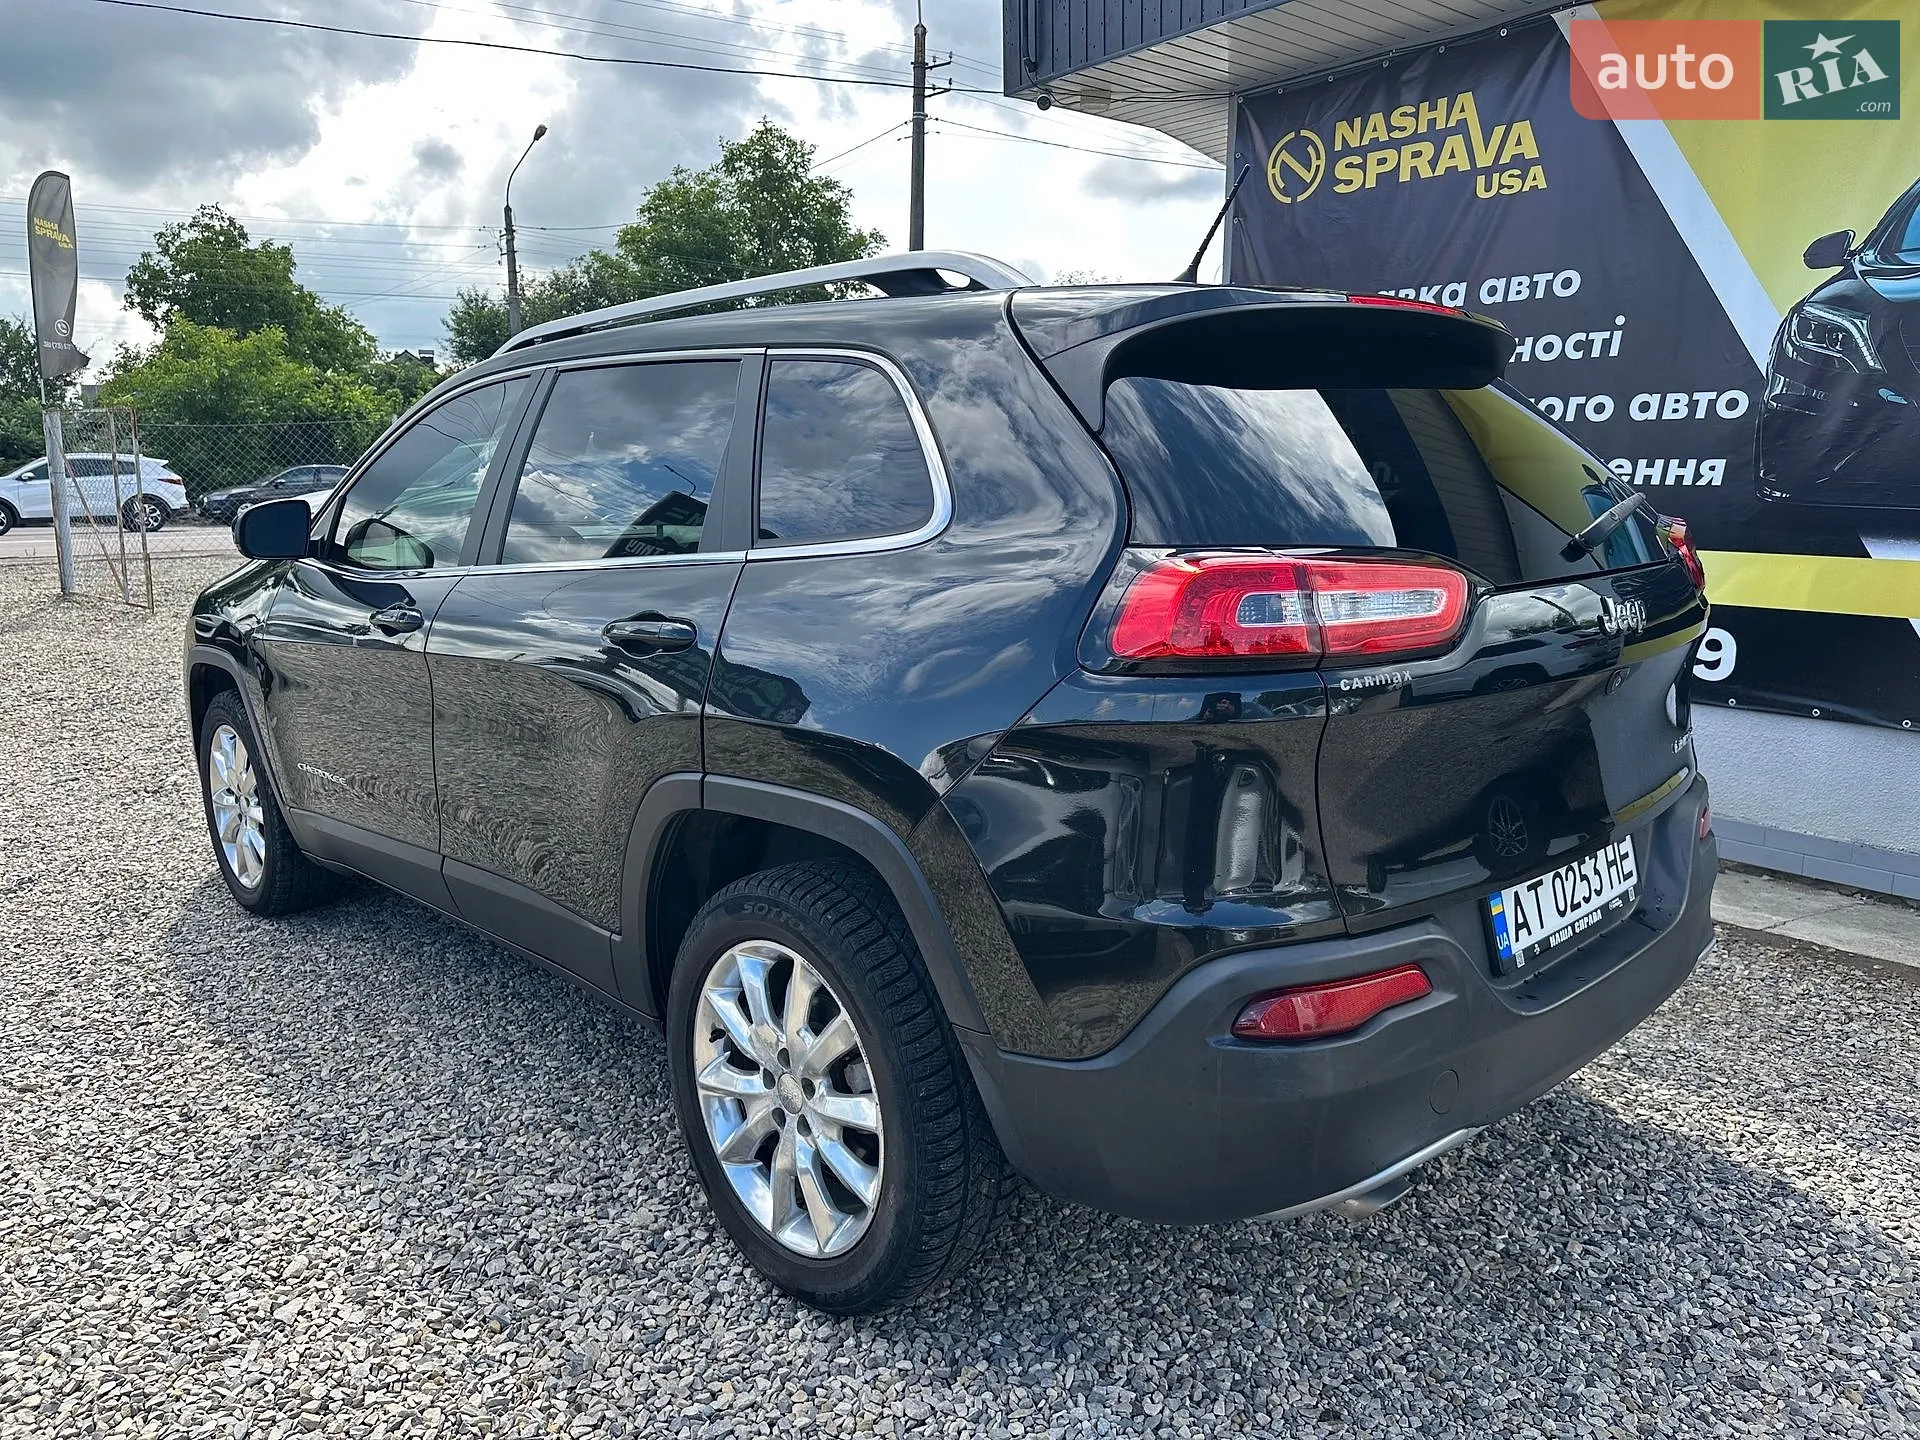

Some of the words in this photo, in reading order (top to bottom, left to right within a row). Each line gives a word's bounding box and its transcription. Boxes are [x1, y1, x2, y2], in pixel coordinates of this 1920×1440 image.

[1333, 91, 1480, 150] NASHA
[1331, 119, 1540, 194] SPRAVA
[1475, 167, 1548, 199] USA
[1479, 269, 1582, 305] авто
[1628, 388, 1749, 421] авто
[1513, 878, 1545, 943] AT
[1552, 853, 1604, 918] 0253
[1605, 840, 1634, 890] HE
[1496, 932, 1510, 950] UA
[1549, 925, 1574, 948] НАША
[1574, 909, 1603, 934] СПРАВА
